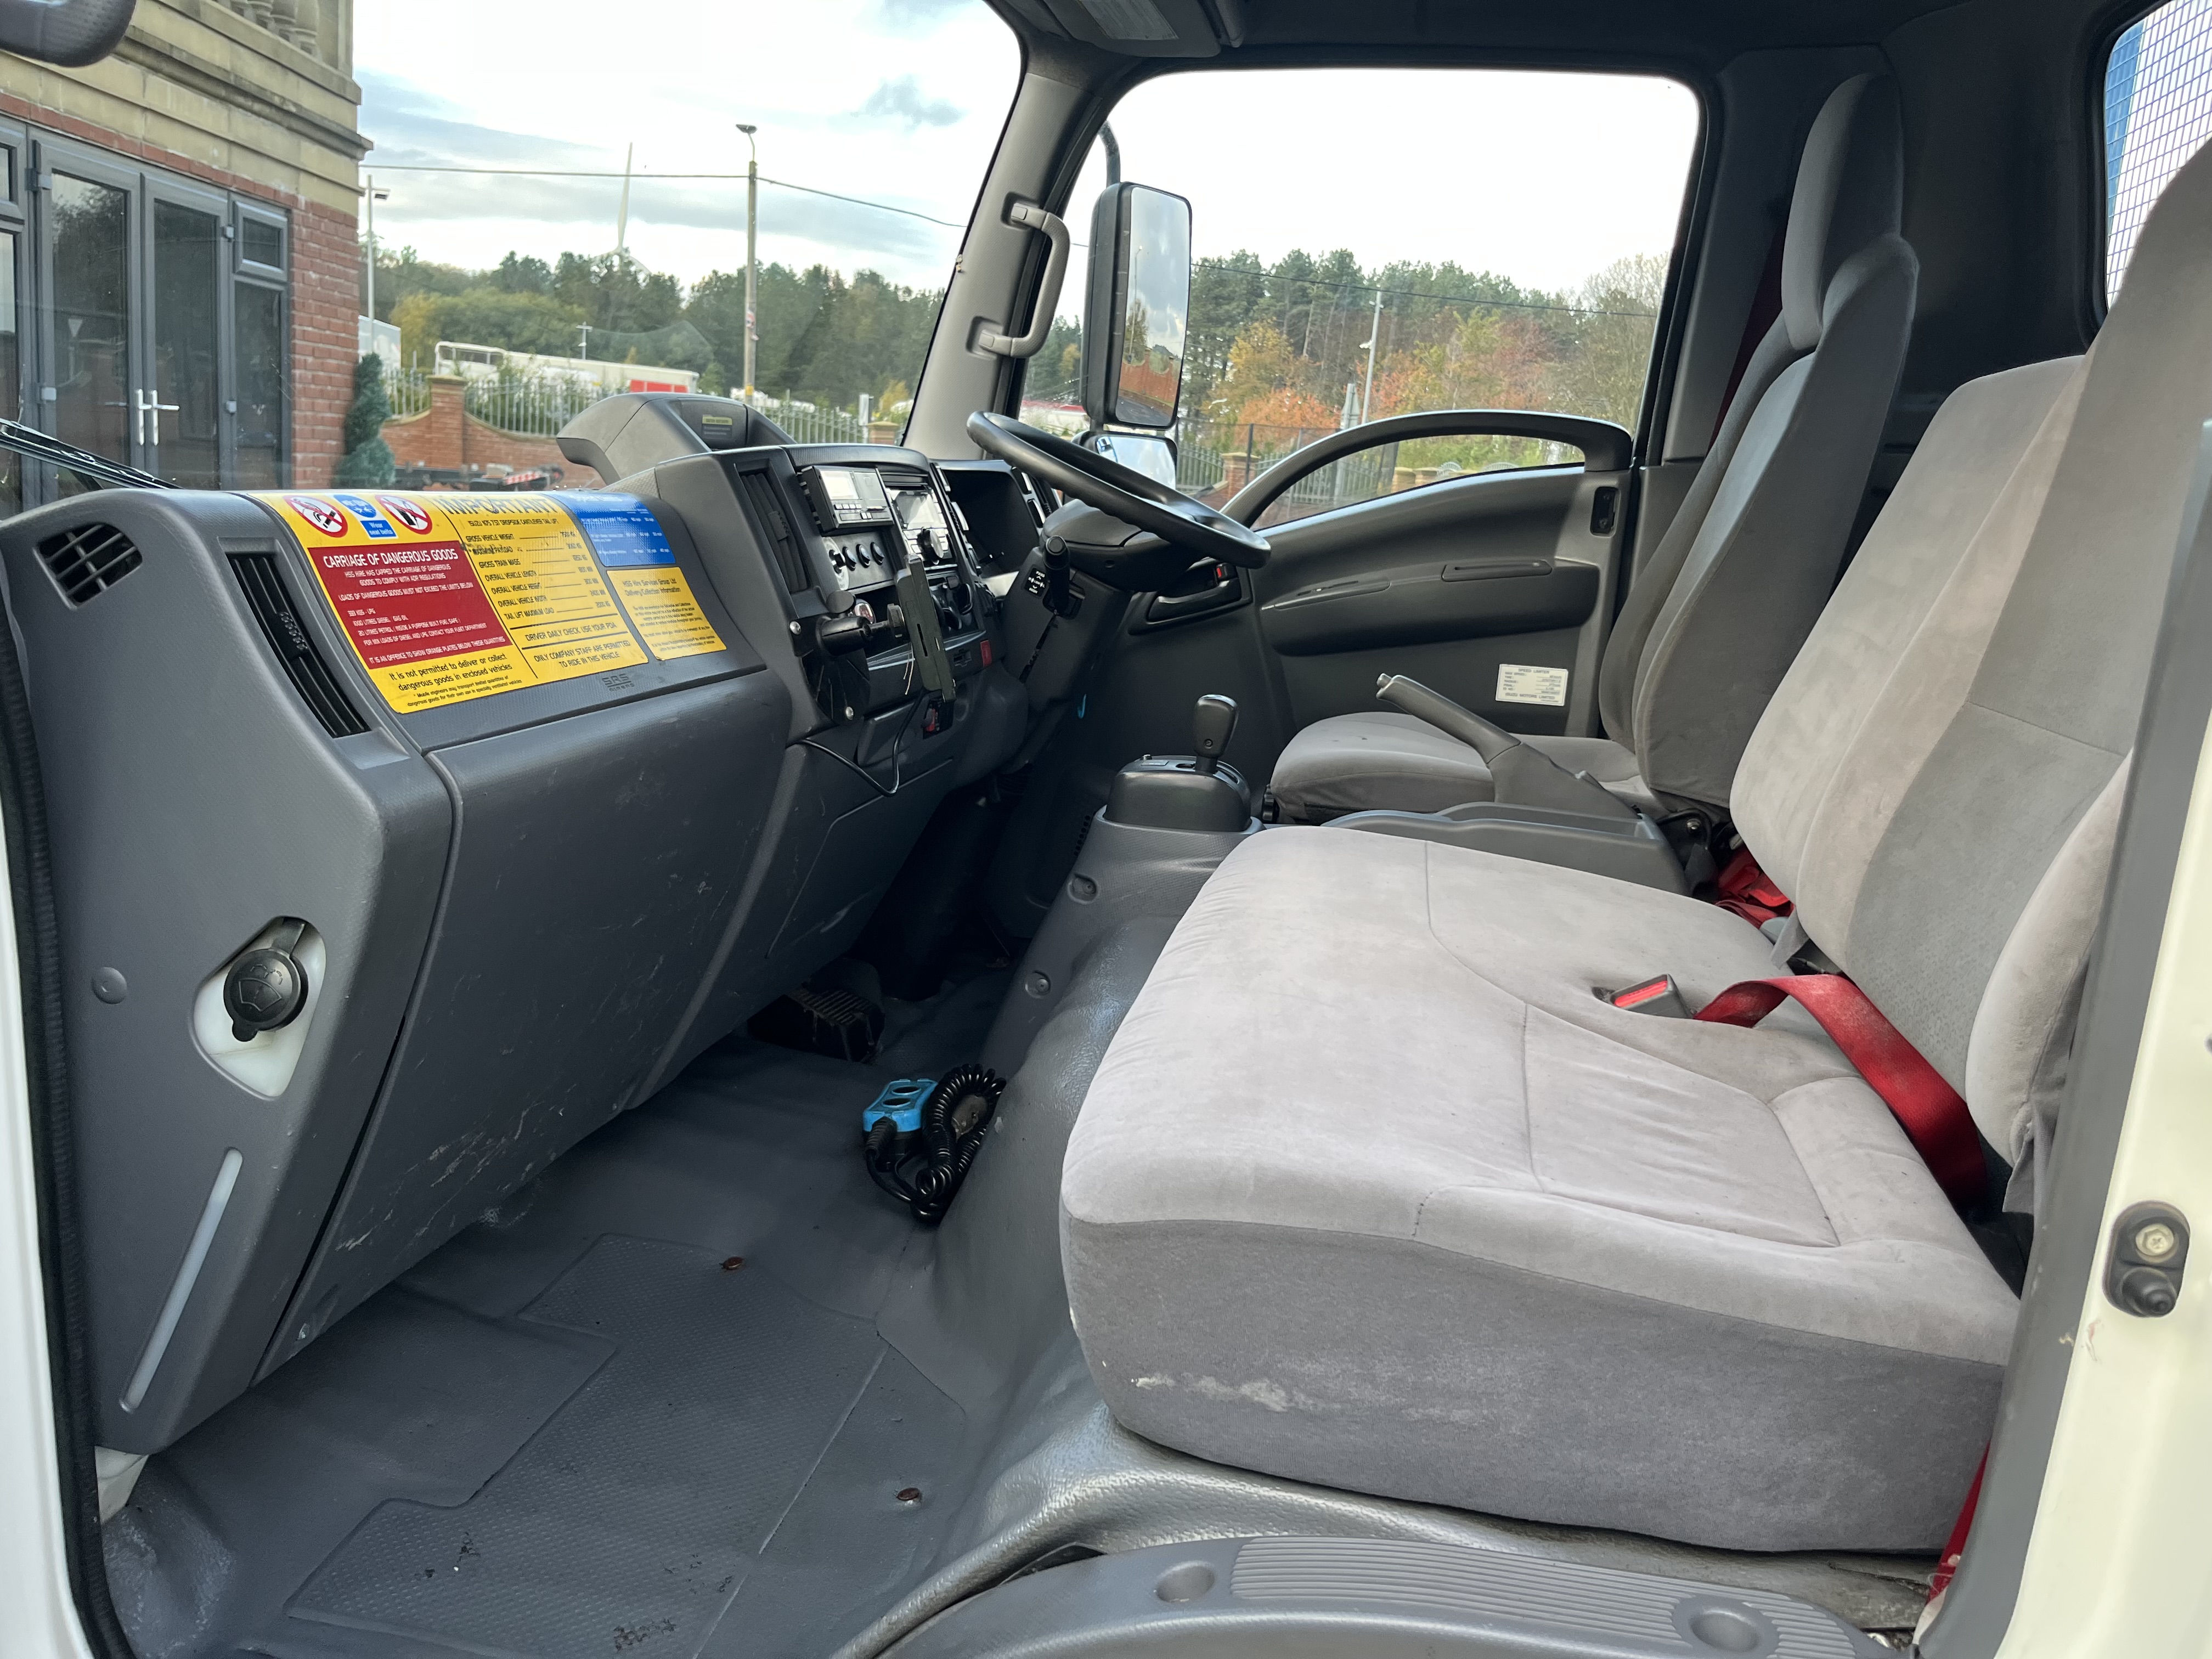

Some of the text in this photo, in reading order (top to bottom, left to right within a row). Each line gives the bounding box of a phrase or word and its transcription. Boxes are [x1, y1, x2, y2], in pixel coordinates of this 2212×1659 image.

[437, 498, 558, 514] IMPORTANT
[323, 549, 459, 568] CARRIAGE OF DANGEROUS GOODS
[485, 573, 505, 582] OVERALL
[360, 590, 388, 599] DANGEROUS
[492, 585, 512, 594] OVERALL
[498, 598, 518, 607] OVERALL
[525, 633, 546, 641] DRIVER
[386, 652, 407, 661] OFFENCE
[425, 647, 443, 655] ORANGE
[442, 644, 459, 652] PLATES
[534, 654, 549, 662] ONLY
[549, 650, 575, 659] COMPANY
[603, 640, 631, 650] PERMITTED
[600, 651, 620, 660] VEHICLE
[405, 669, 418, 678] not
[418, 664, 449, 676] permitted
[458, 659, 478, 668] deliver
[487, 653, 507, 663] collect
[398, 680, 433, 691] dangerous
[433, 675, 454, 685] goods
[462, 668, 489, 678] enclosed
[489, 663, 512, 674] vehicles
[602, 674, 629, 685] SRS
